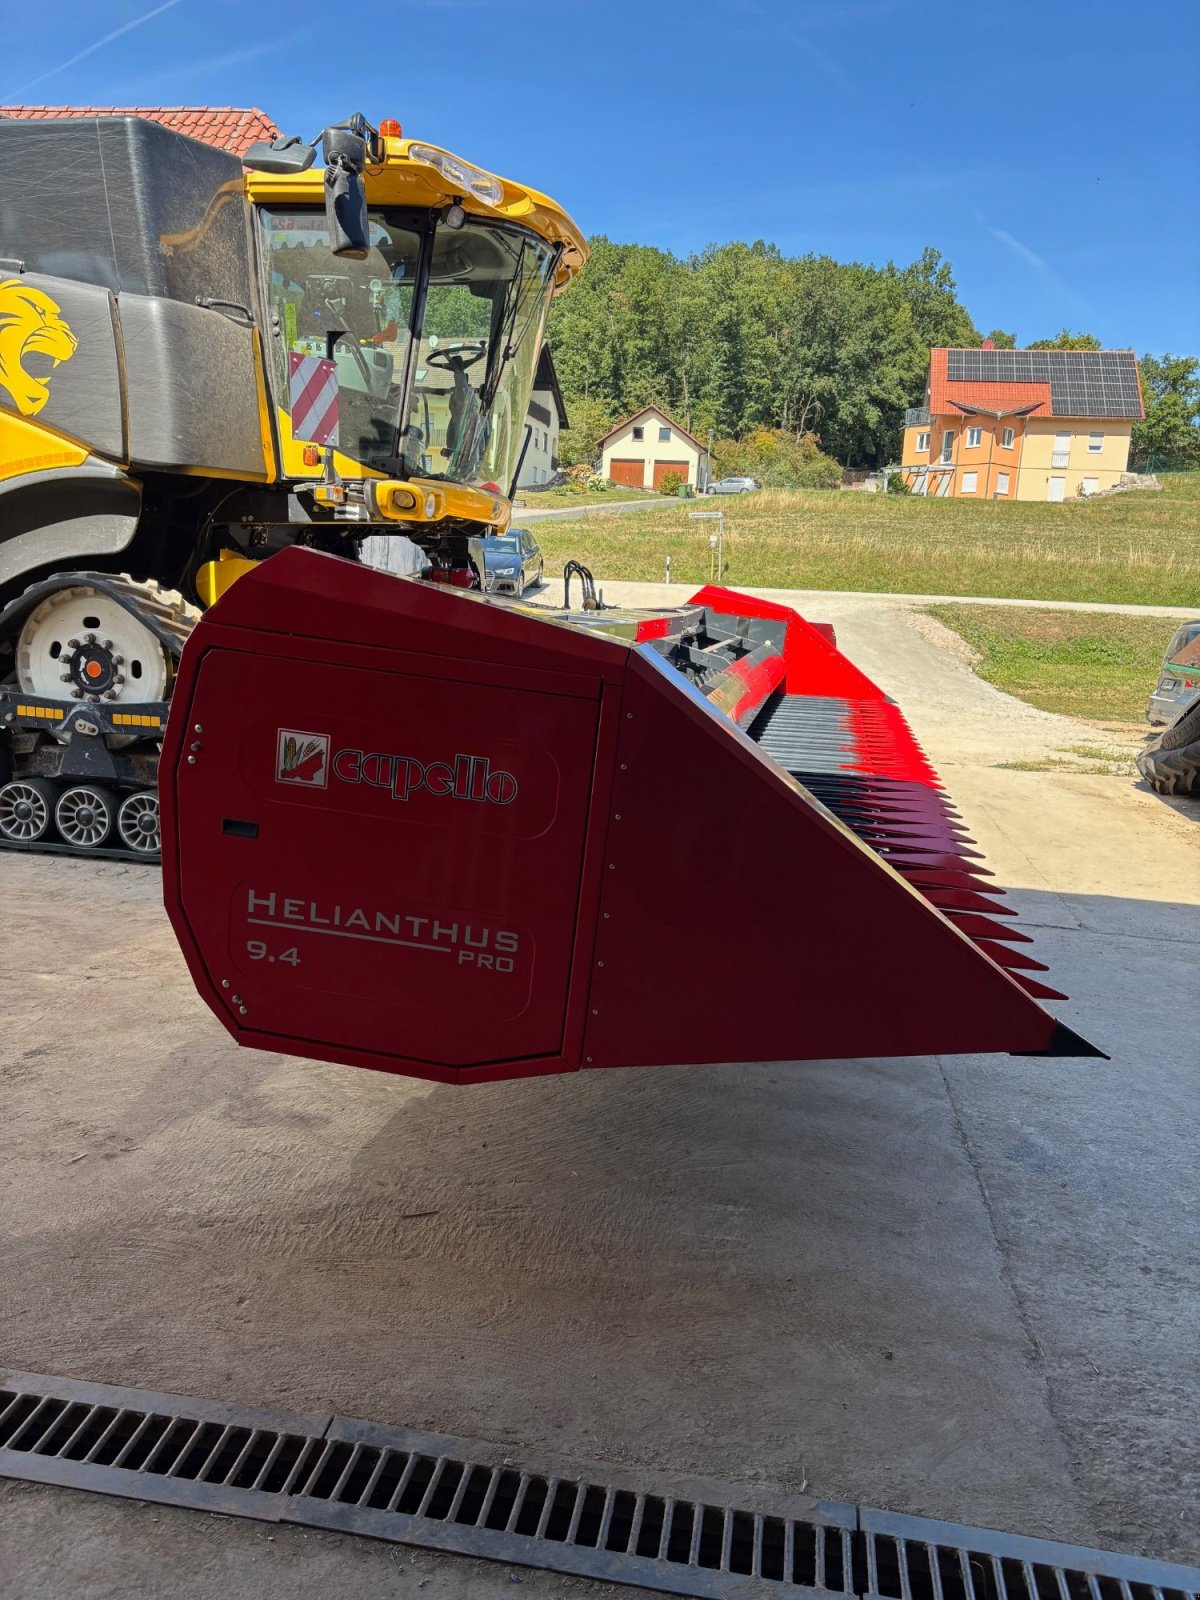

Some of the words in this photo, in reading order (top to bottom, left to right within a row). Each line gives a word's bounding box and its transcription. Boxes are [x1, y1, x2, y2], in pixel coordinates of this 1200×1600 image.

[247, 889, 519, 953] HELIANTHUS
[246, 940, 301, 967] 9.4
[457, 950, 514, 973] PRO
